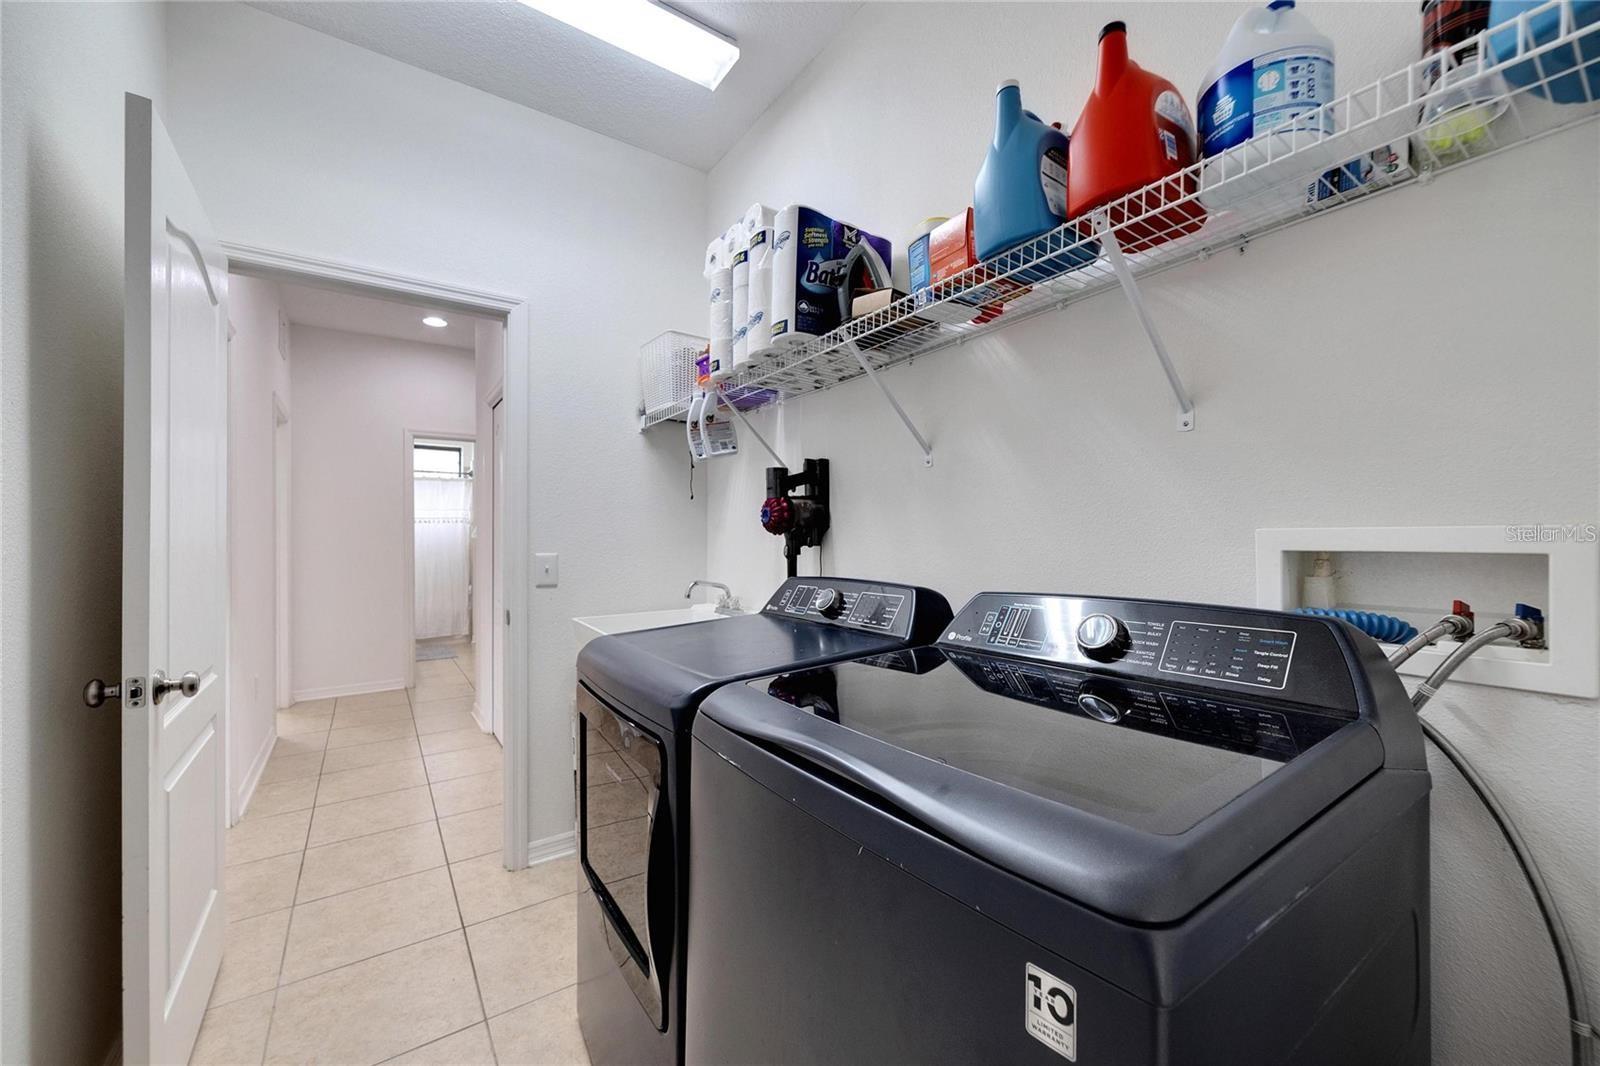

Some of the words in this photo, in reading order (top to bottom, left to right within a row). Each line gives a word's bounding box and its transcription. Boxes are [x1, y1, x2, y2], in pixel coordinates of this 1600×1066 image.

[955, 633, 973, 642] Profile
[1269, 651, 1289, 659] Control
[1028, 974, 1074, 1026] 10
[1032, 1022, 1070, 1050] WARRANTY
[1036, 1018, 1064, 1041] LIMITED
